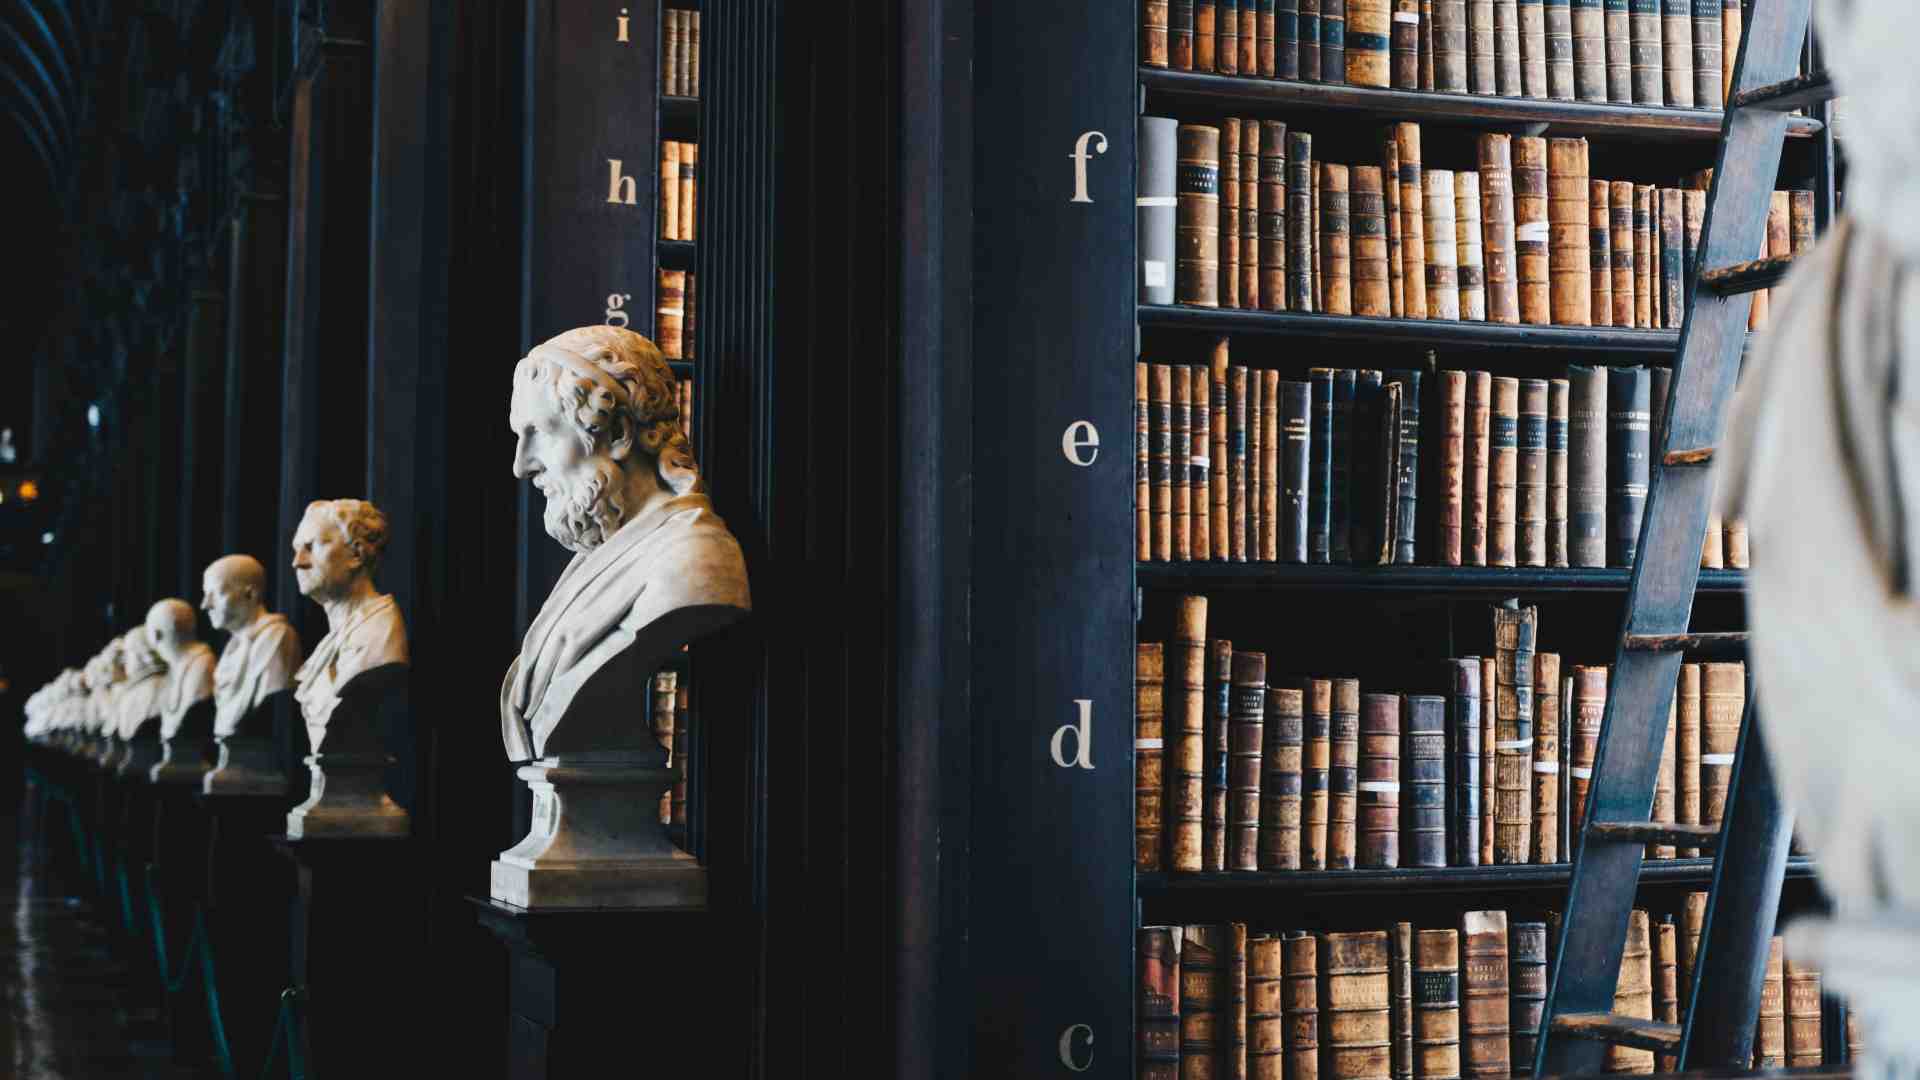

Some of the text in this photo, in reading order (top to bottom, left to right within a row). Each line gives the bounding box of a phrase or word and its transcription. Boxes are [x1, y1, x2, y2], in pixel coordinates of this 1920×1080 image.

[617, 8, 630, 42] i
[606, 159, 637, 204] h
[1069, 131, 1108, 203] f
[605, 293, 631, 327] g
[1062, 420, 1100, 467] e
[1050, 699, 1096, 770] d
[1059, 1023, 1094, 1072] c
